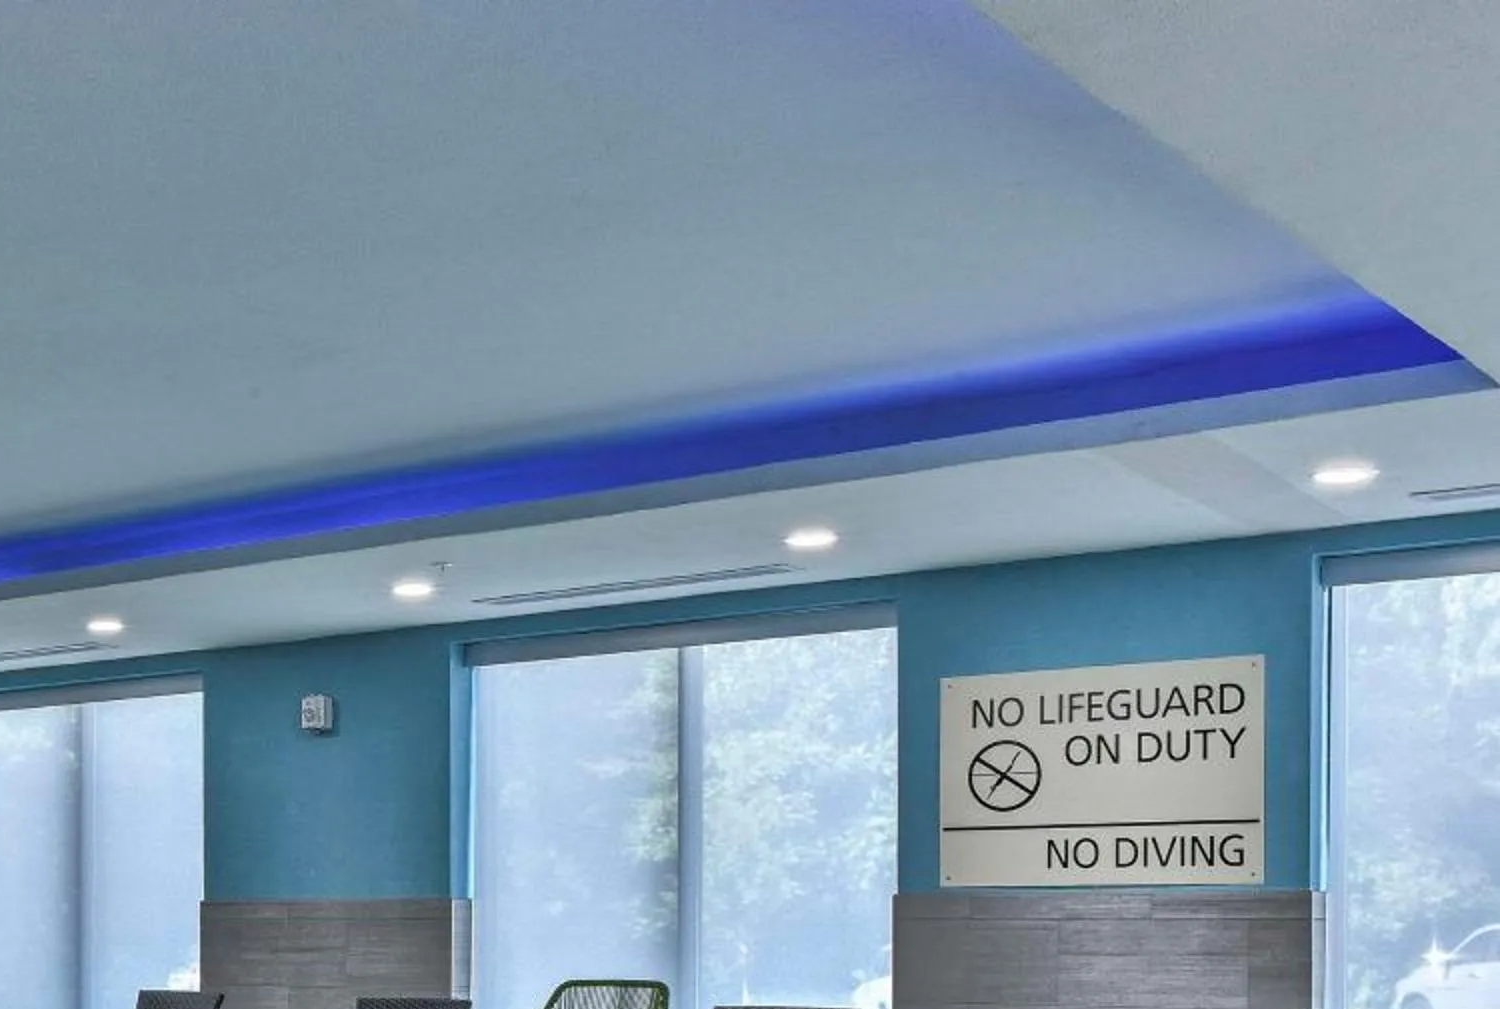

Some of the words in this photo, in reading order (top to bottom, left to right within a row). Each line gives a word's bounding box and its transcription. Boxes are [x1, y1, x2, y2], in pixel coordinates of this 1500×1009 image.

[971, 697, 1025, 728] NO
[1039, 683, 1246, 725] LIFEGUARD
[1065, 733, 1121, 766] ON
[1137, 726, 1246, 763] DUTY
[1046, 837, 1100, 869] NO
[1115, 834, 1246, 869] DIVING
